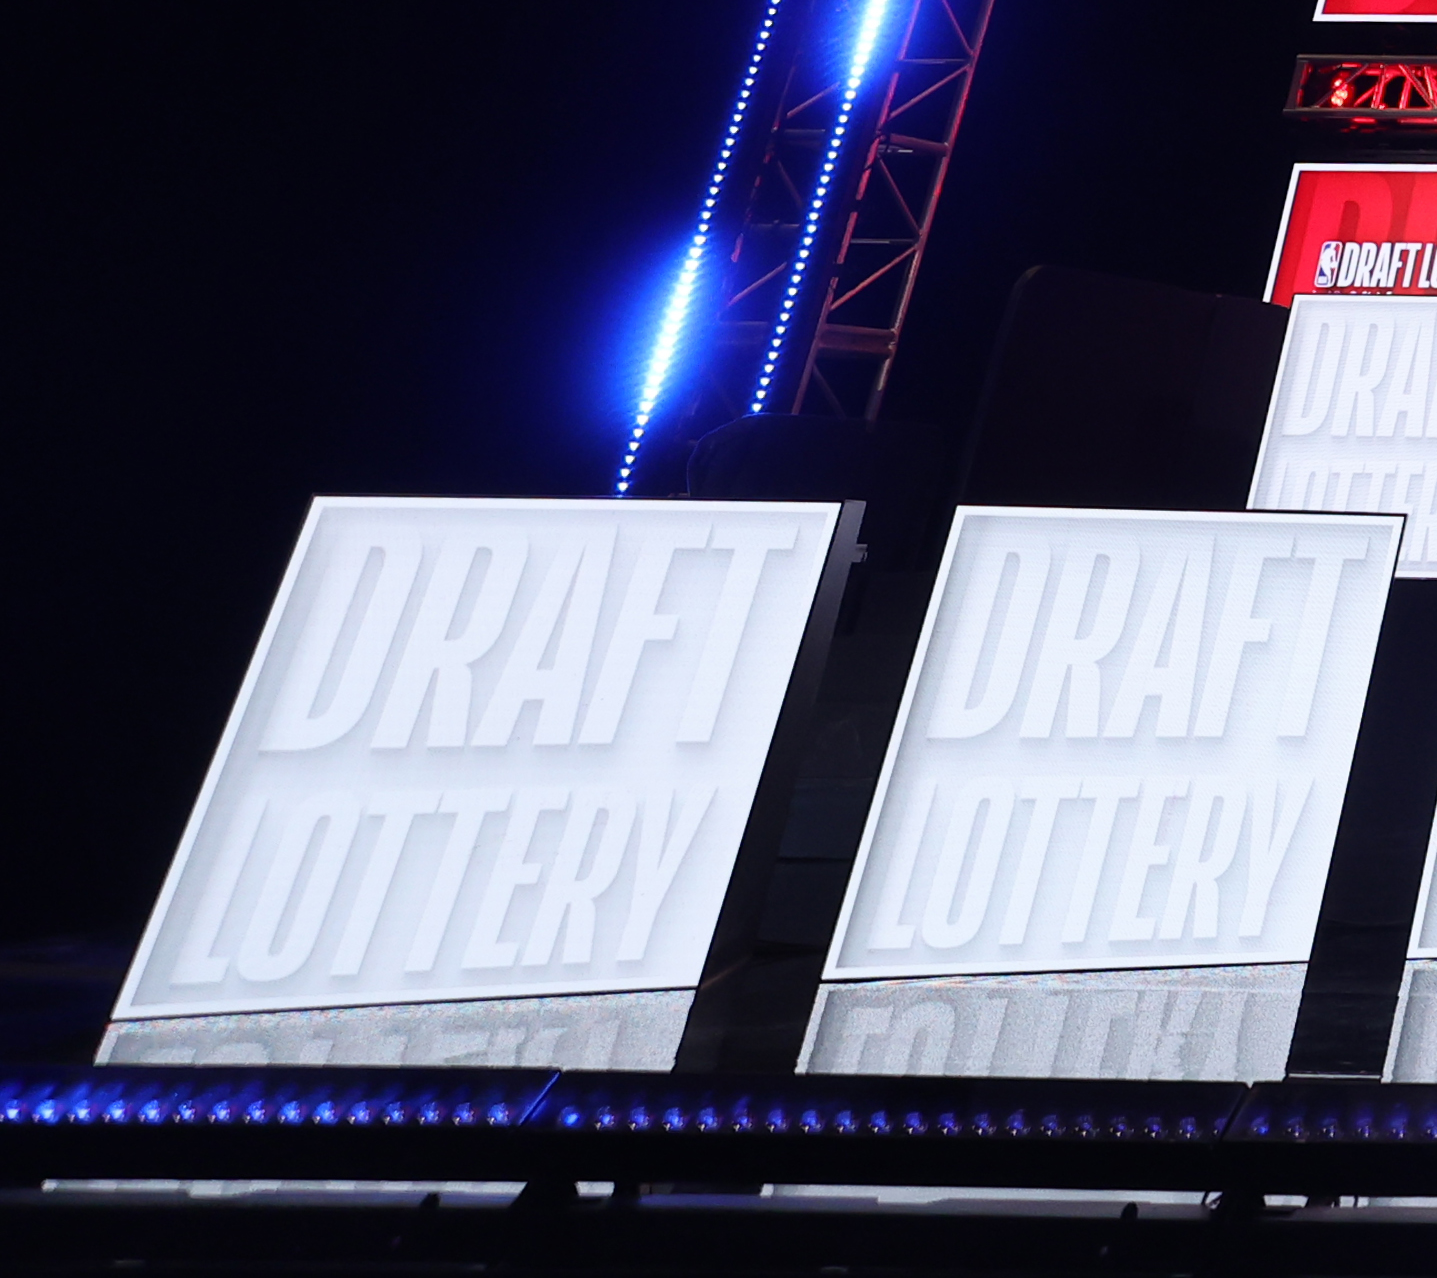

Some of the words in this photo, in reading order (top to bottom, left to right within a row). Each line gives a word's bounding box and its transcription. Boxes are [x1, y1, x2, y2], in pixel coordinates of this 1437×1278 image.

[1336, 242, 1423, 289] DRAFT
[257, 523, 800, 754] DRAFT
[925, 533, 1372, 741] DRAFT
[168, 785, 720, 986] LOTTERY
[866, 772, 1317, 951] LOTTERY
